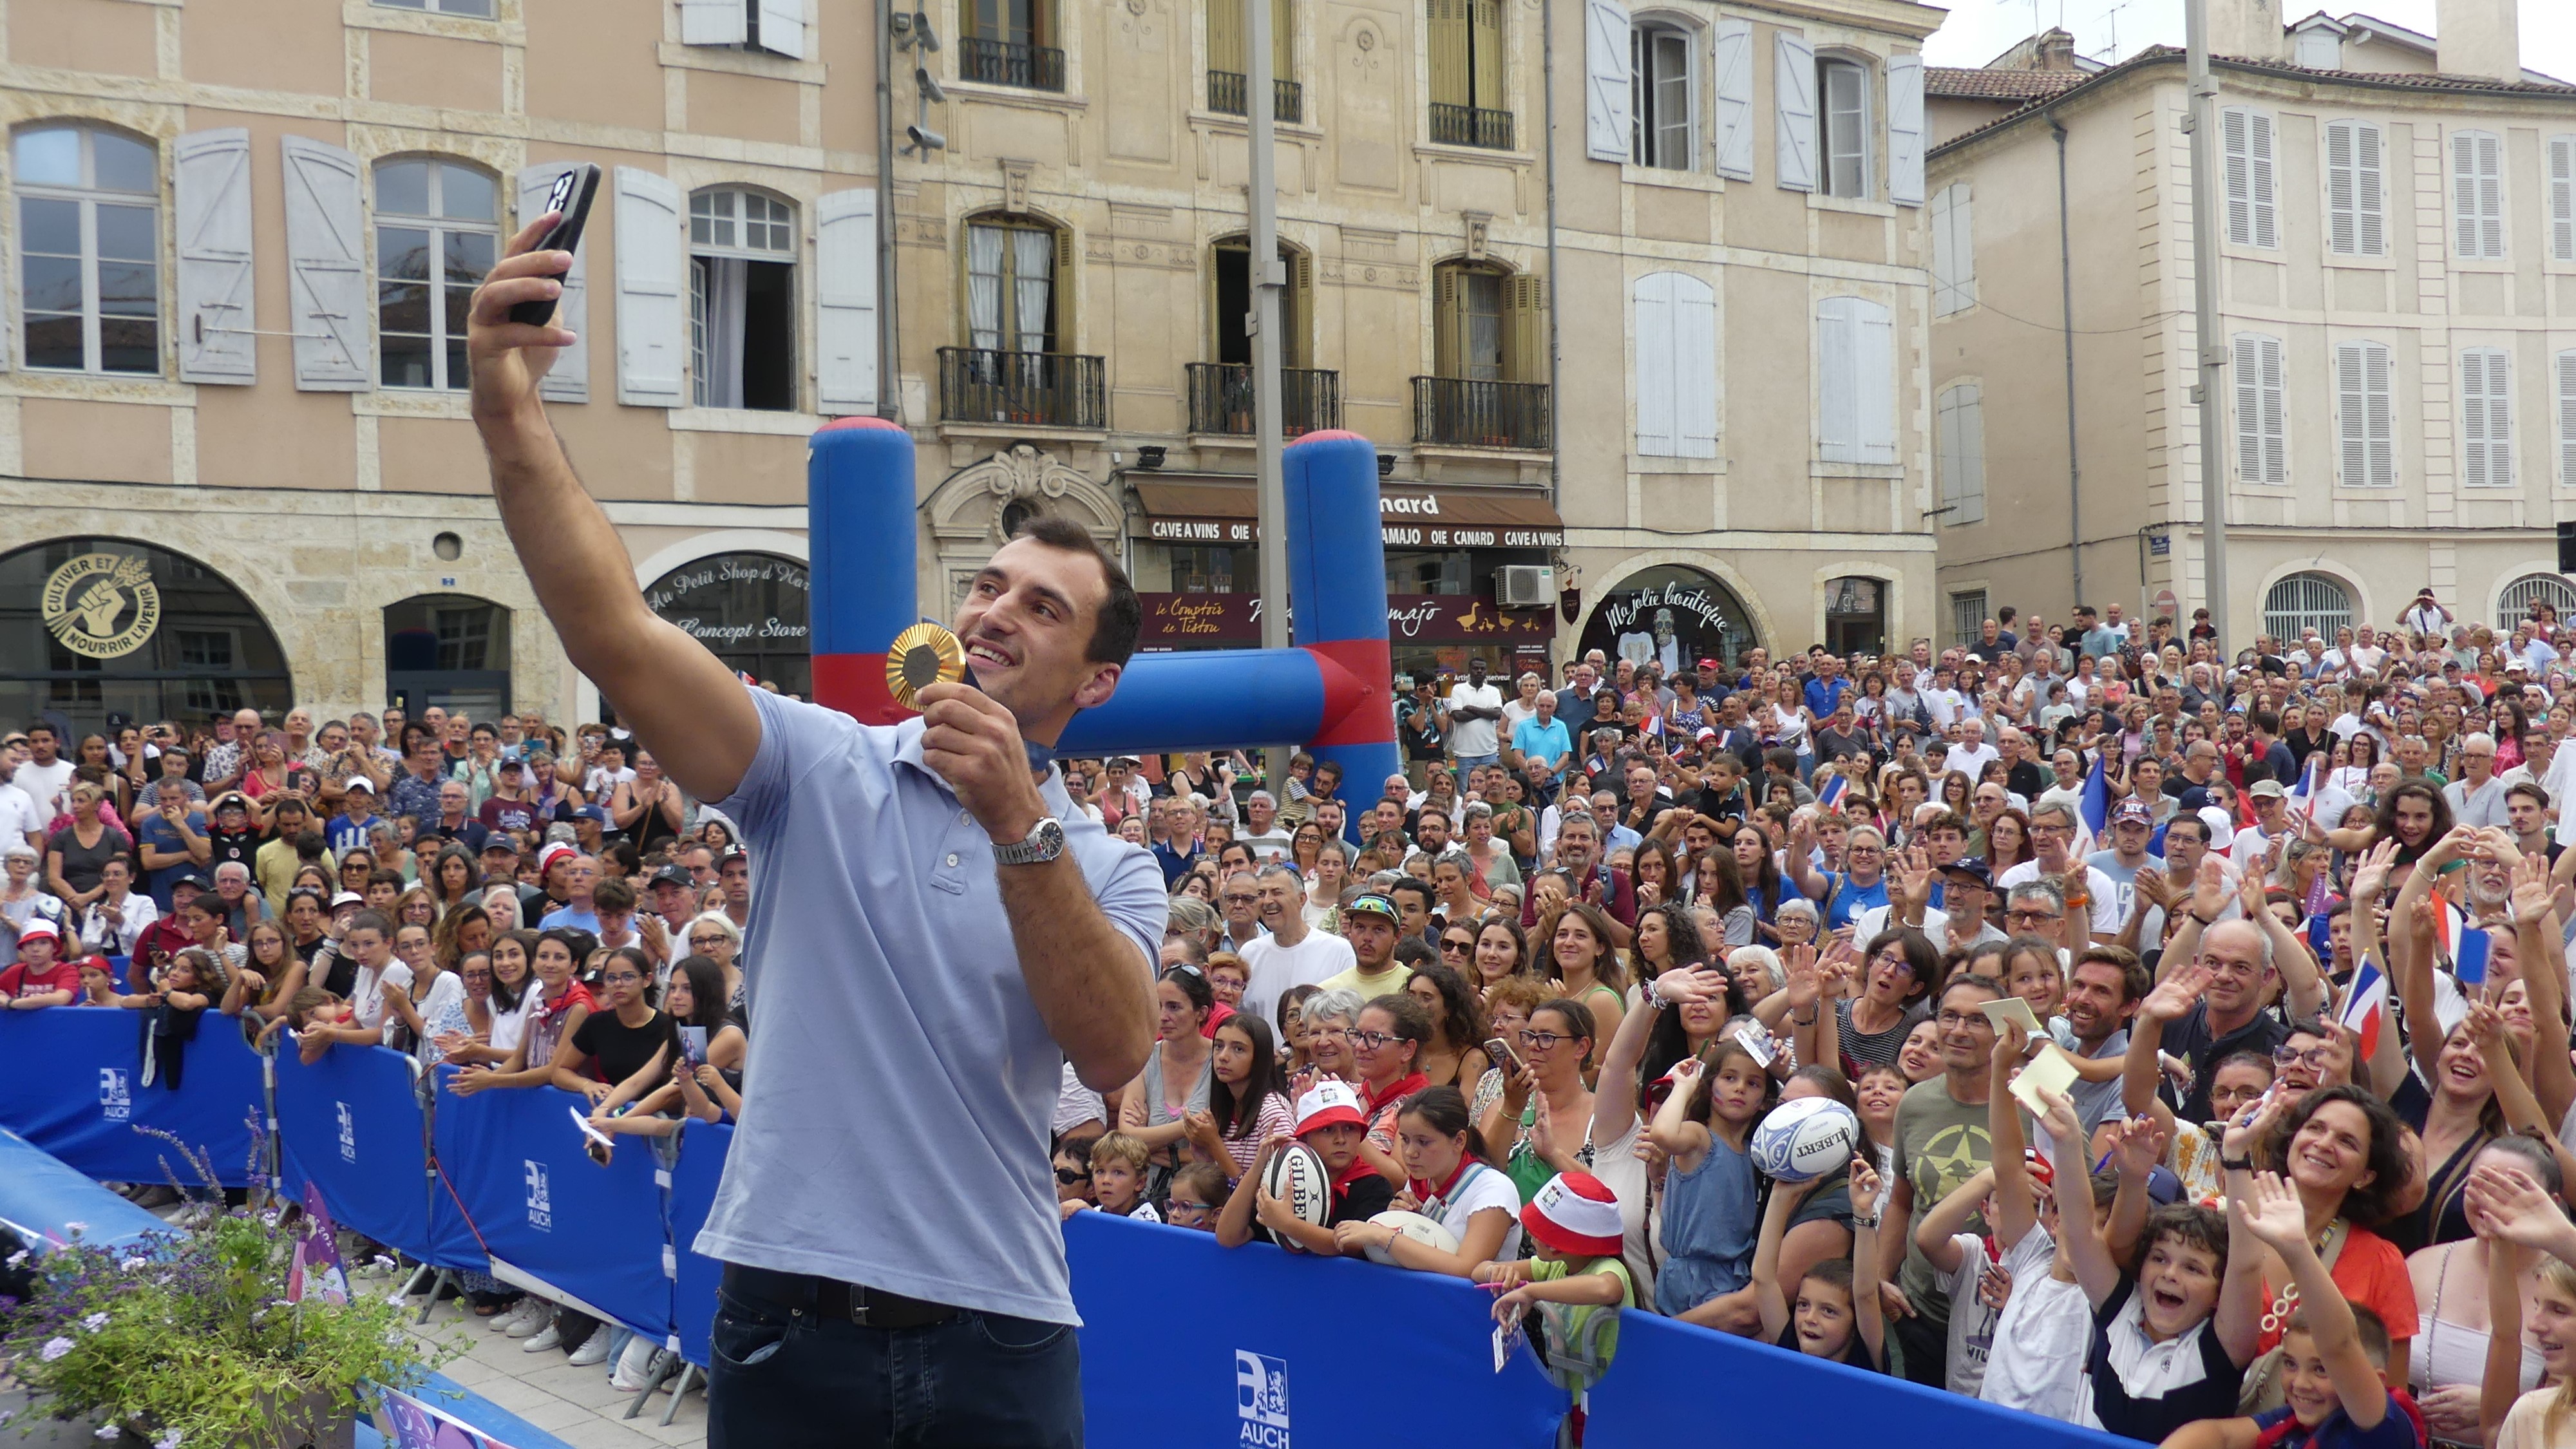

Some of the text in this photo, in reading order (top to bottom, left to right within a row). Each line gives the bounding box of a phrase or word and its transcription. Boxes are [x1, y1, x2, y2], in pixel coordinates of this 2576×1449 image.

[1152, 522, 1220, 539] CAVE A VINS
[1231, 525, 1249, 540] OIE
[1431, 530, 1495, 545] OIE CANARD
[1504, 532, 1562, 546] CAVE A VINS
[48, 558, 112, 613] CULTIVER ET
[649, 591, 674, 612] Au
[674, 571, 715, 594] Petit
[719, 561, 760, 584] Shop
[67, 586, 155, 653] NOURRIR L'AVENIR
[1170, 596, 1225, 619] Comptoir
[1388, 601, 1442, 636] majo
[1605, 581, 1727, 636] Ma jolie boutique
[677, 617, 810, 643] Concept Store
[1162, 616, 1220, 634] de Tistou
[2125, 803, 2144, 813] NY
[1291, 1155, 1306, 1222] GILBE
[529, 1209, 552, 1227] AUCH
[1240, 1421, 1289, 1449] AUCH
